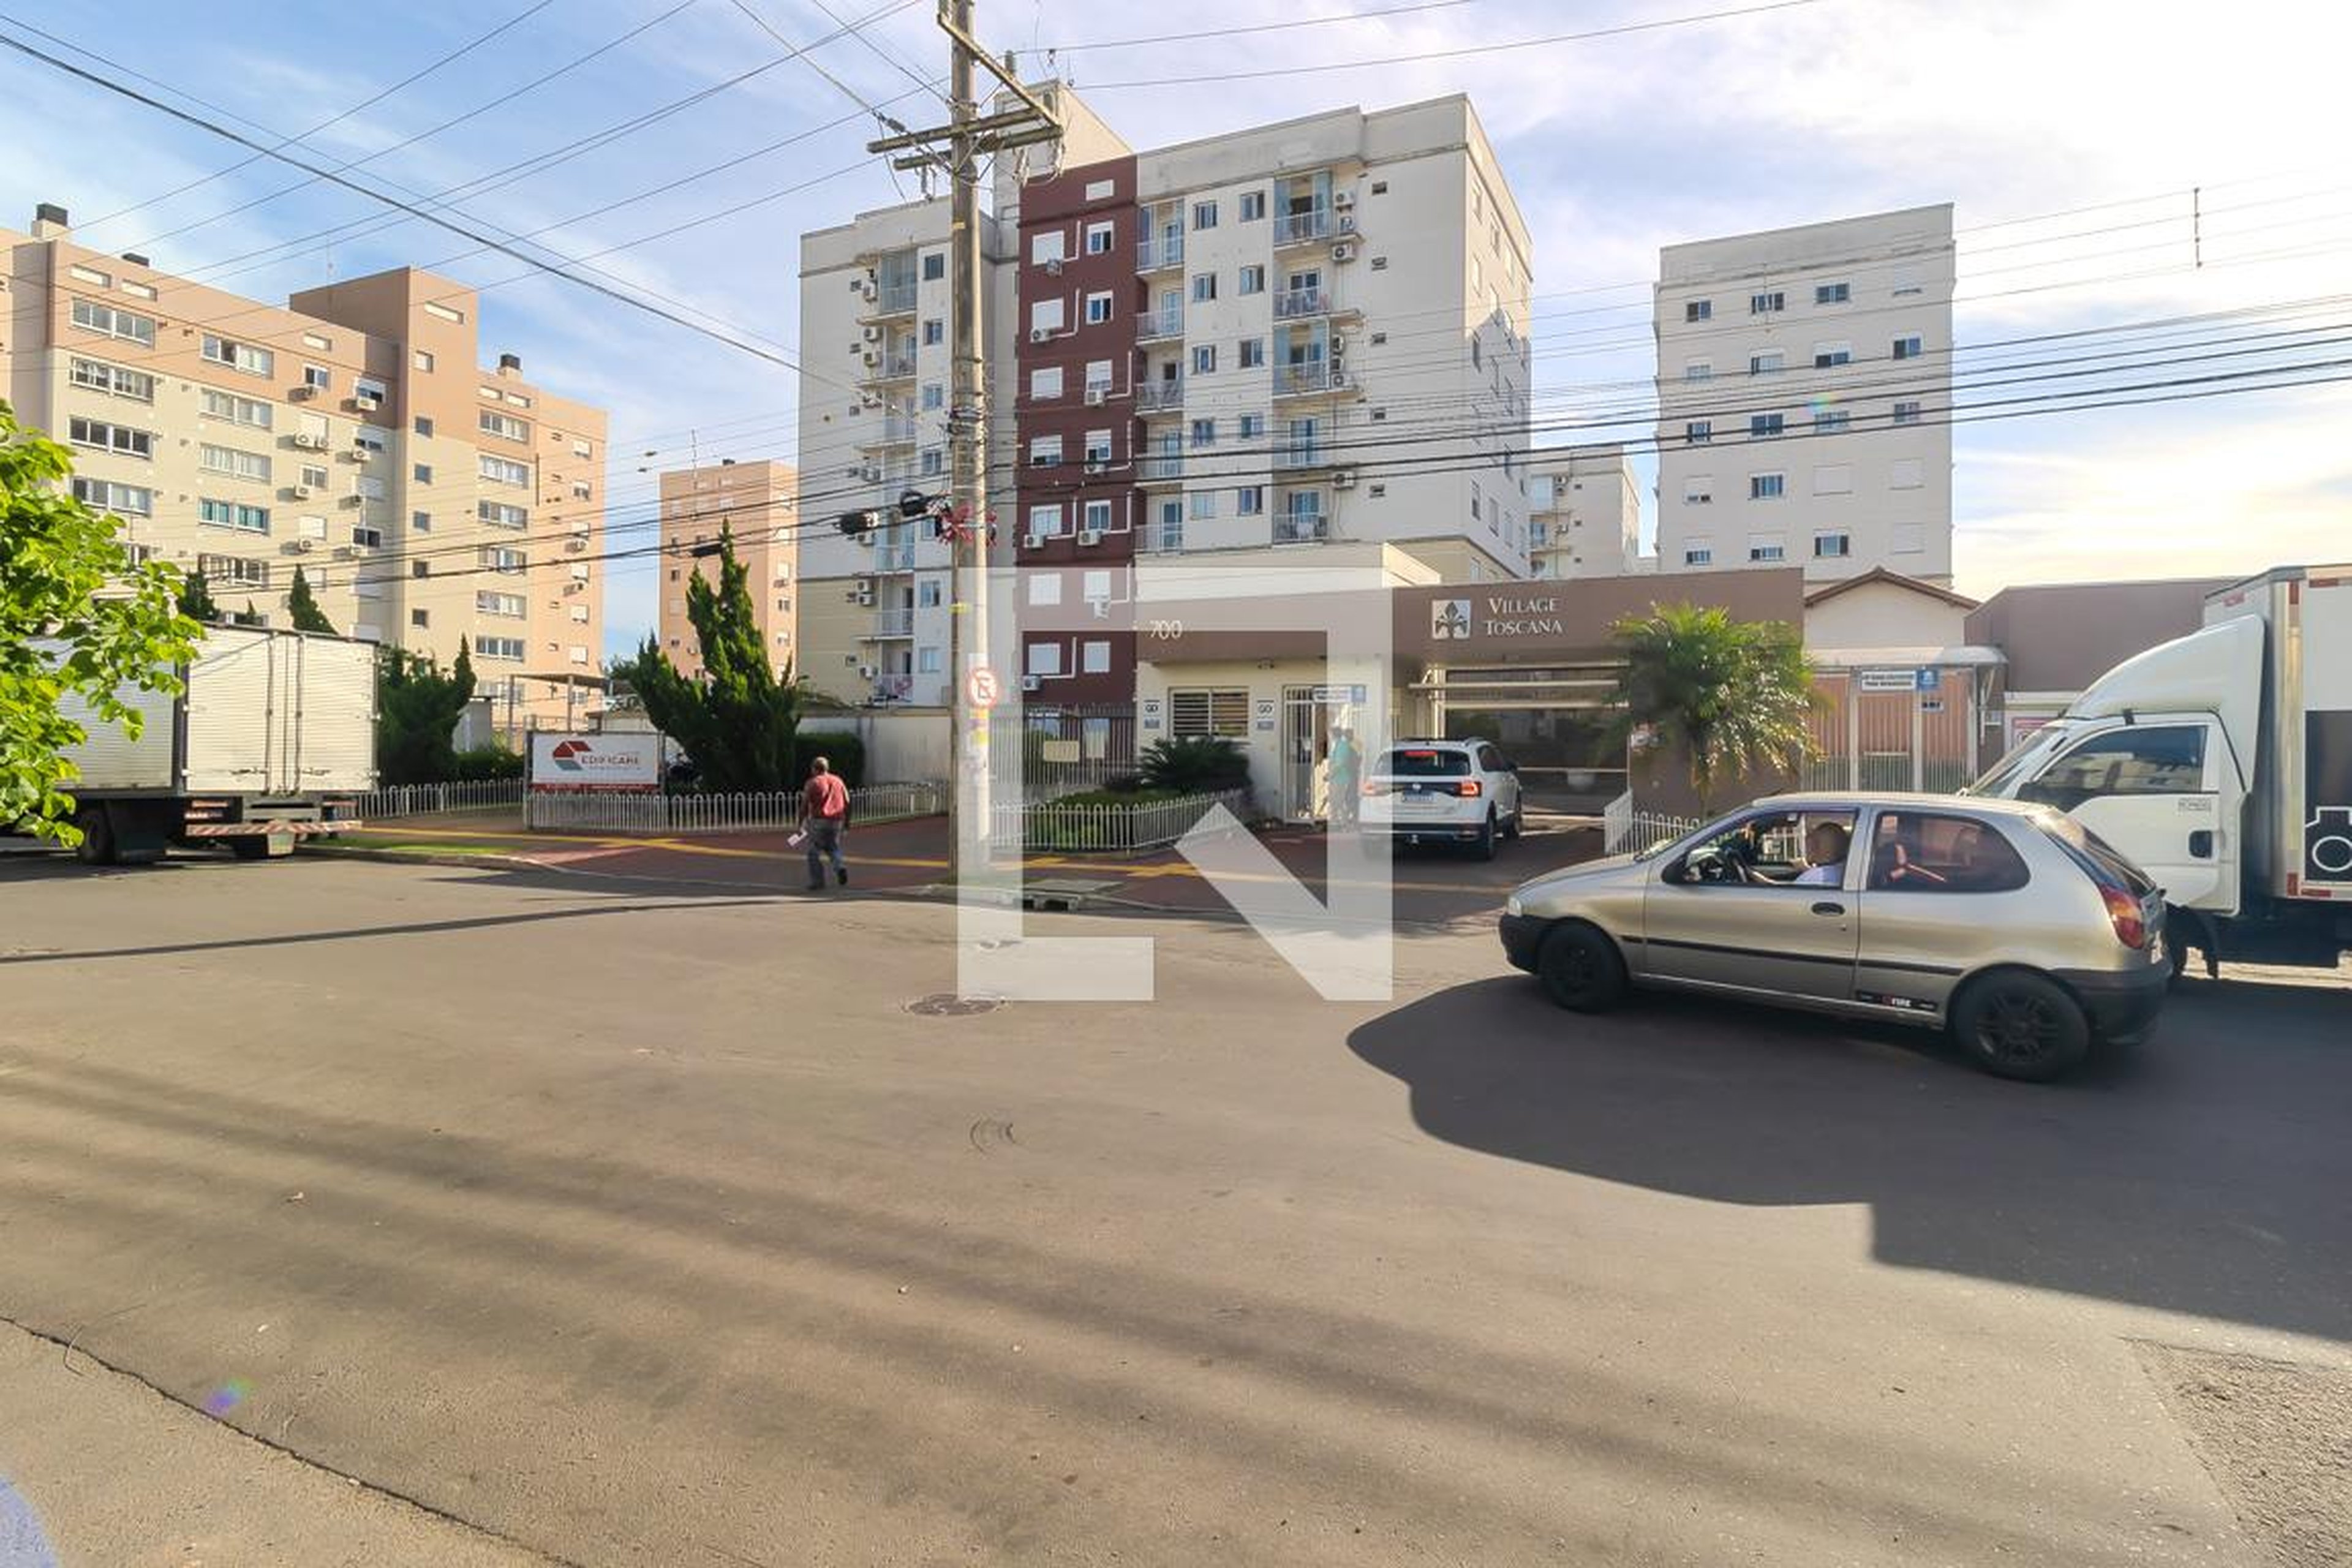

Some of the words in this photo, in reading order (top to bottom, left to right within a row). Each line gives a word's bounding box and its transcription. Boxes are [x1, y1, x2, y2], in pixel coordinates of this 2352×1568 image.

[1488, 597, 1560, 614] VILLAGE
[1149, 620, 1182, 639] 700
[1483, 619, 1563, 636] TOSCANA
